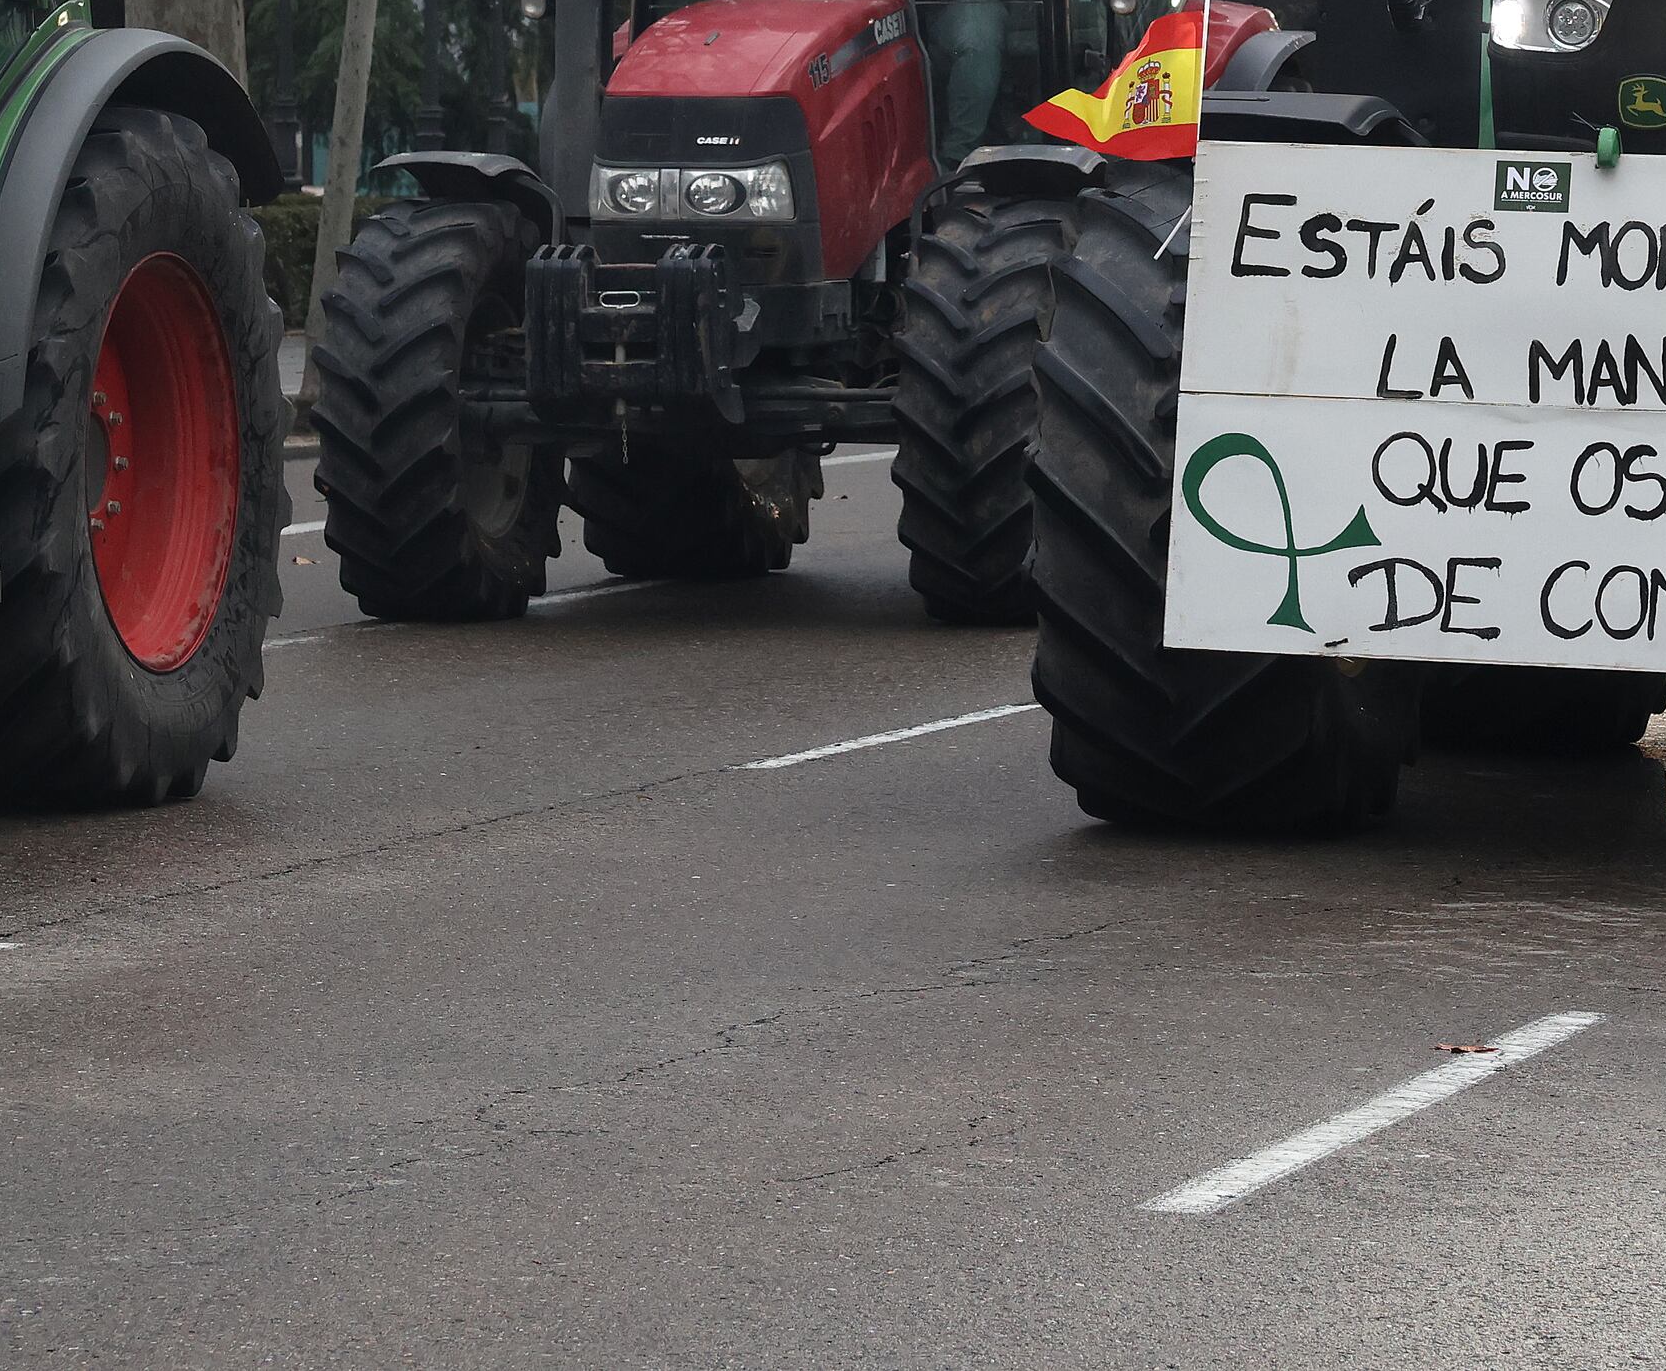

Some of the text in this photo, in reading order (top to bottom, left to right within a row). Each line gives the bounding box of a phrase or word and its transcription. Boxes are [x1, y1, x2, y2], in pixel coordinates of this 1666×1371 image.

[874, 14, 900, 45] CASE
[808, 52, 831, 92] 115
[696, 137, 727, 146] CASE
[1500, 191, 1509, 199] A
[1510, 191, 1563, 201] MERCOSUR
[1231, 193, 1507, 285] ESTÁIS
[1375, 333, 1476, 401] LA
[1371, 429, 1535, 517] QUE
[1348, 557, 1502, 639] DE
